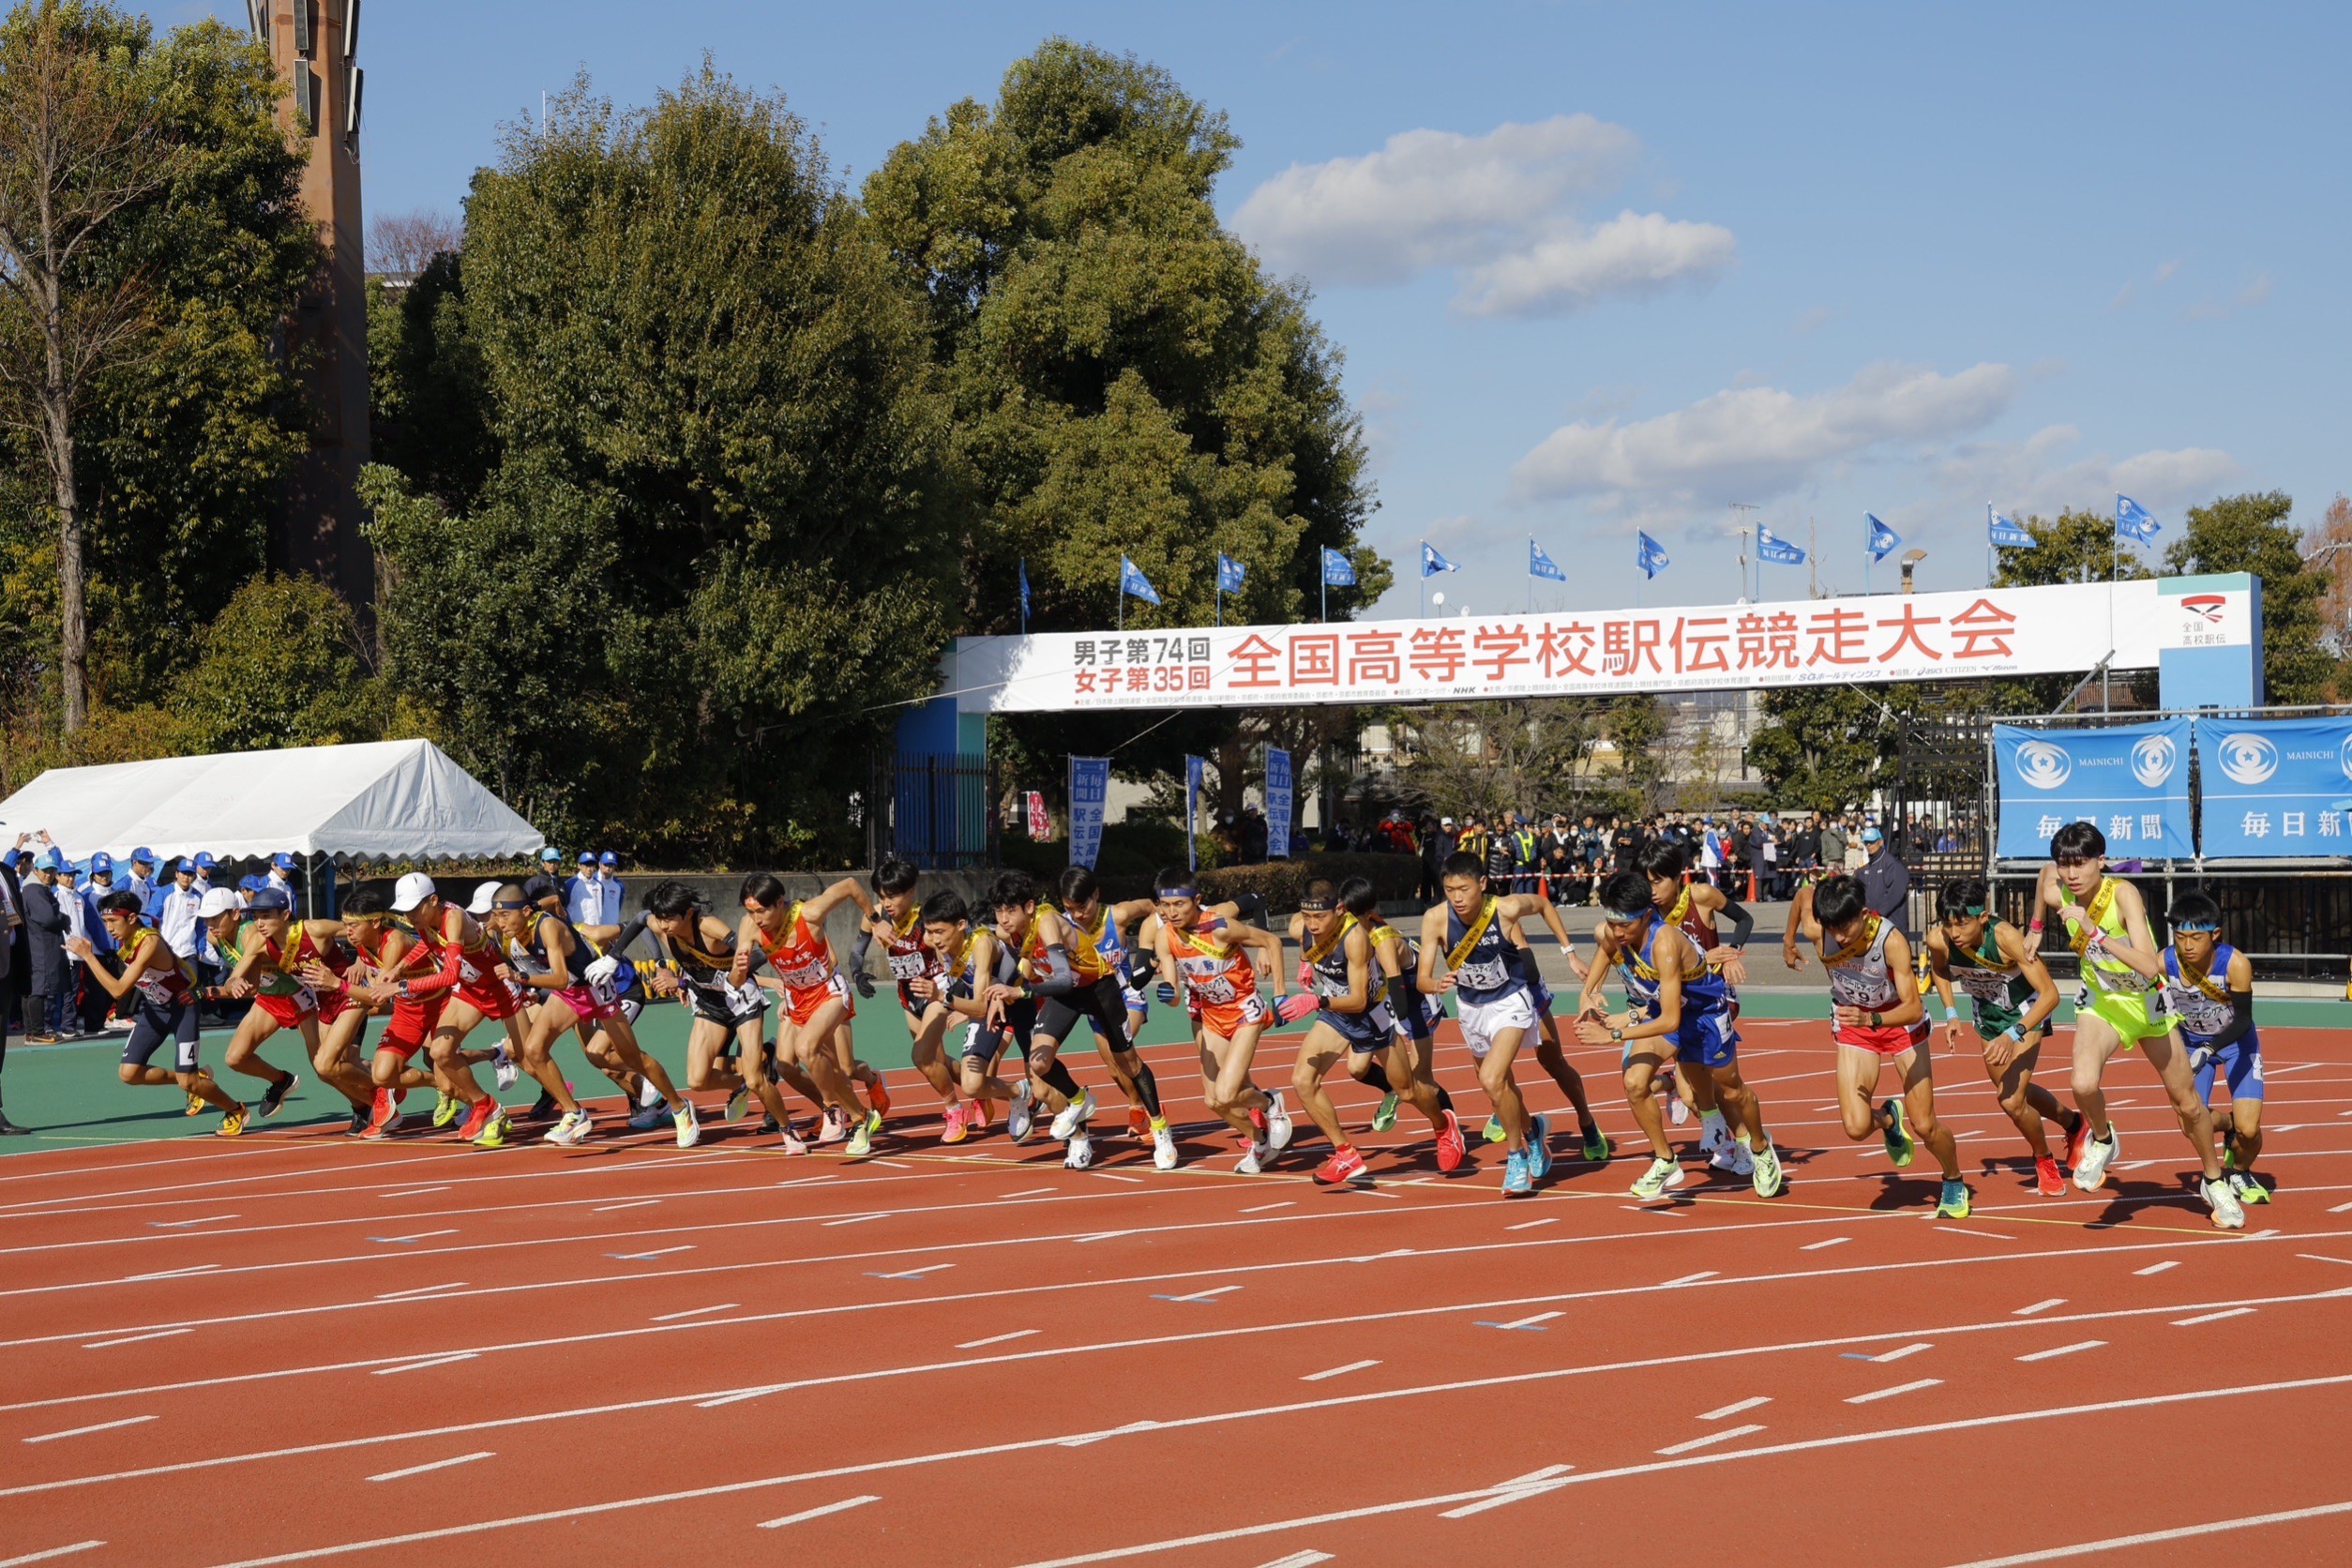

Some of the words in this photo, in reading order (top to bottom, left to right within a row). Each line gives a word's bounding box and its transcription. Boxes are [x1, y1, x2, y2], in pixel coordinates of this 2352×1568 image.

[2182, 621, 2204, 633] 全国
[1227, 597, 2015, 687] 全国高等学校駅伝競走大会
[2182, 633, 2226, 646] 高校駅伝
[1075, 636, 1211, 666] 男子第74回
[1945, 665, 1977, 674] CITIZEN
[1075, 665, 1211, 694] 女子第35回
[2079, 757, 2124, 767] MAINICHI
[2286, 750, 2334, 761] MAINICHI
[1073, 807, 1087, 866] 駅伝大
[1465, 971, 1503, 986] 12-1
[1384, 991, 1395, 1009] 8
[1844, 986, 1885, 1003] 29-1
[2154, 993, 2168, 1015] 4
[188, 1044, 196, 1062] 4
